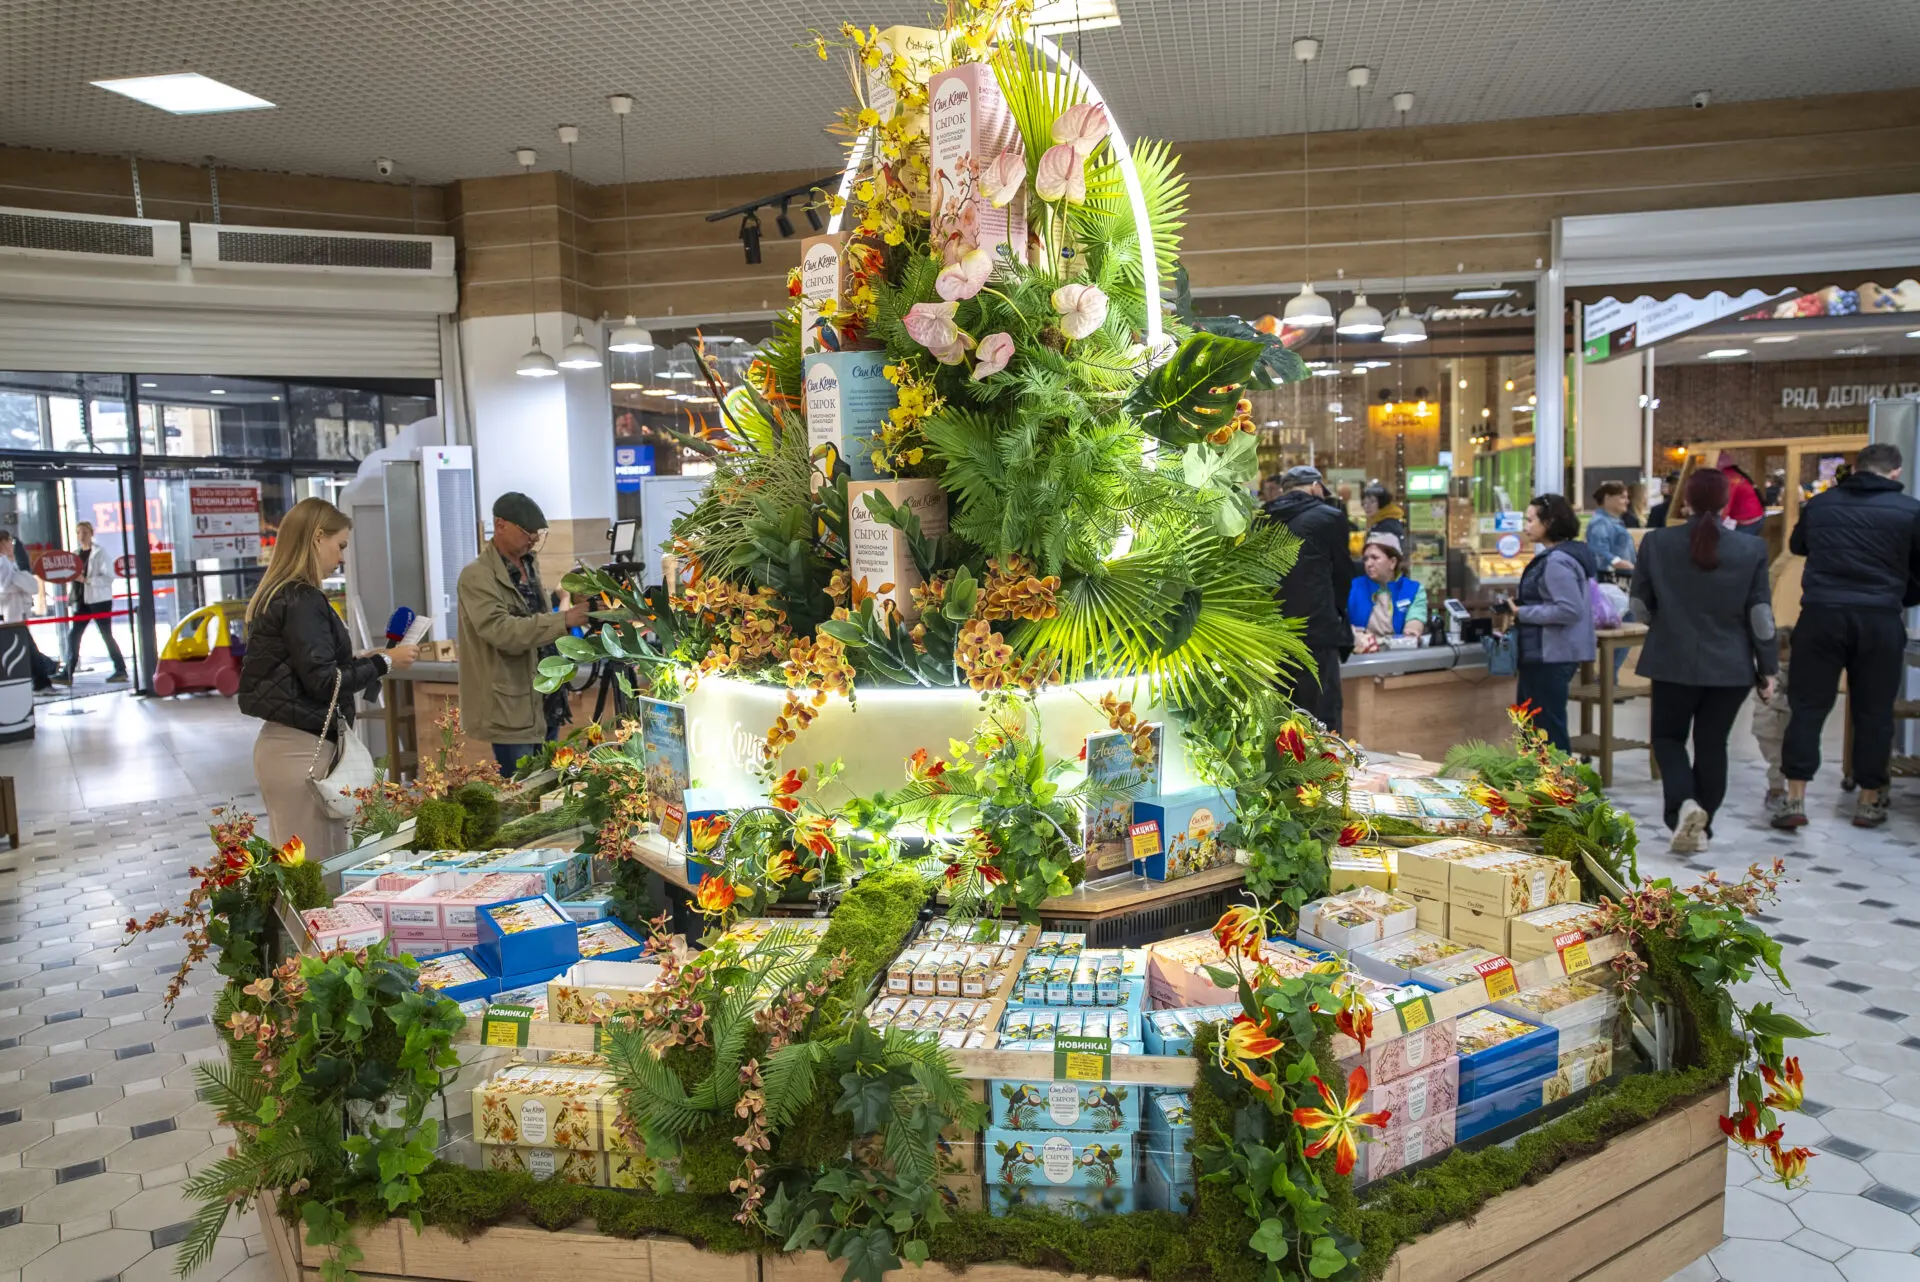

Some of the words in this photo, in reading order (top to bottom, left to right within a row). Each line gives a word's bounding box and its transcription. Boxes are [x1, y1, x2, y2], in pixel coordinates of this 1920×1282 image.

[936, 113, 966, 130] СЫРОК
[805, 274, 834, 288] СЫРОК
[852, 365, 868, 378] Сан
[809, 399, 836, 409] СЫРОК
[1781, 387, 1820, 410] РЯД
[852, 506, 866, 520] Сан
[854, 528, 888, 541] СЫРОК
[42, 555, 76, 569] ВЫХОД
[1131, 823, 1158, 836] АКЦИЯ!
[1555, 931, 1582, 947] АКЦИЯ!
[1478, 957, 1508, 974] АКЦИЯ!
[488, 1008, 530, 1018] НОВИНКА!
[1058, 1041, 1107, 1050] НОВИНКА!
